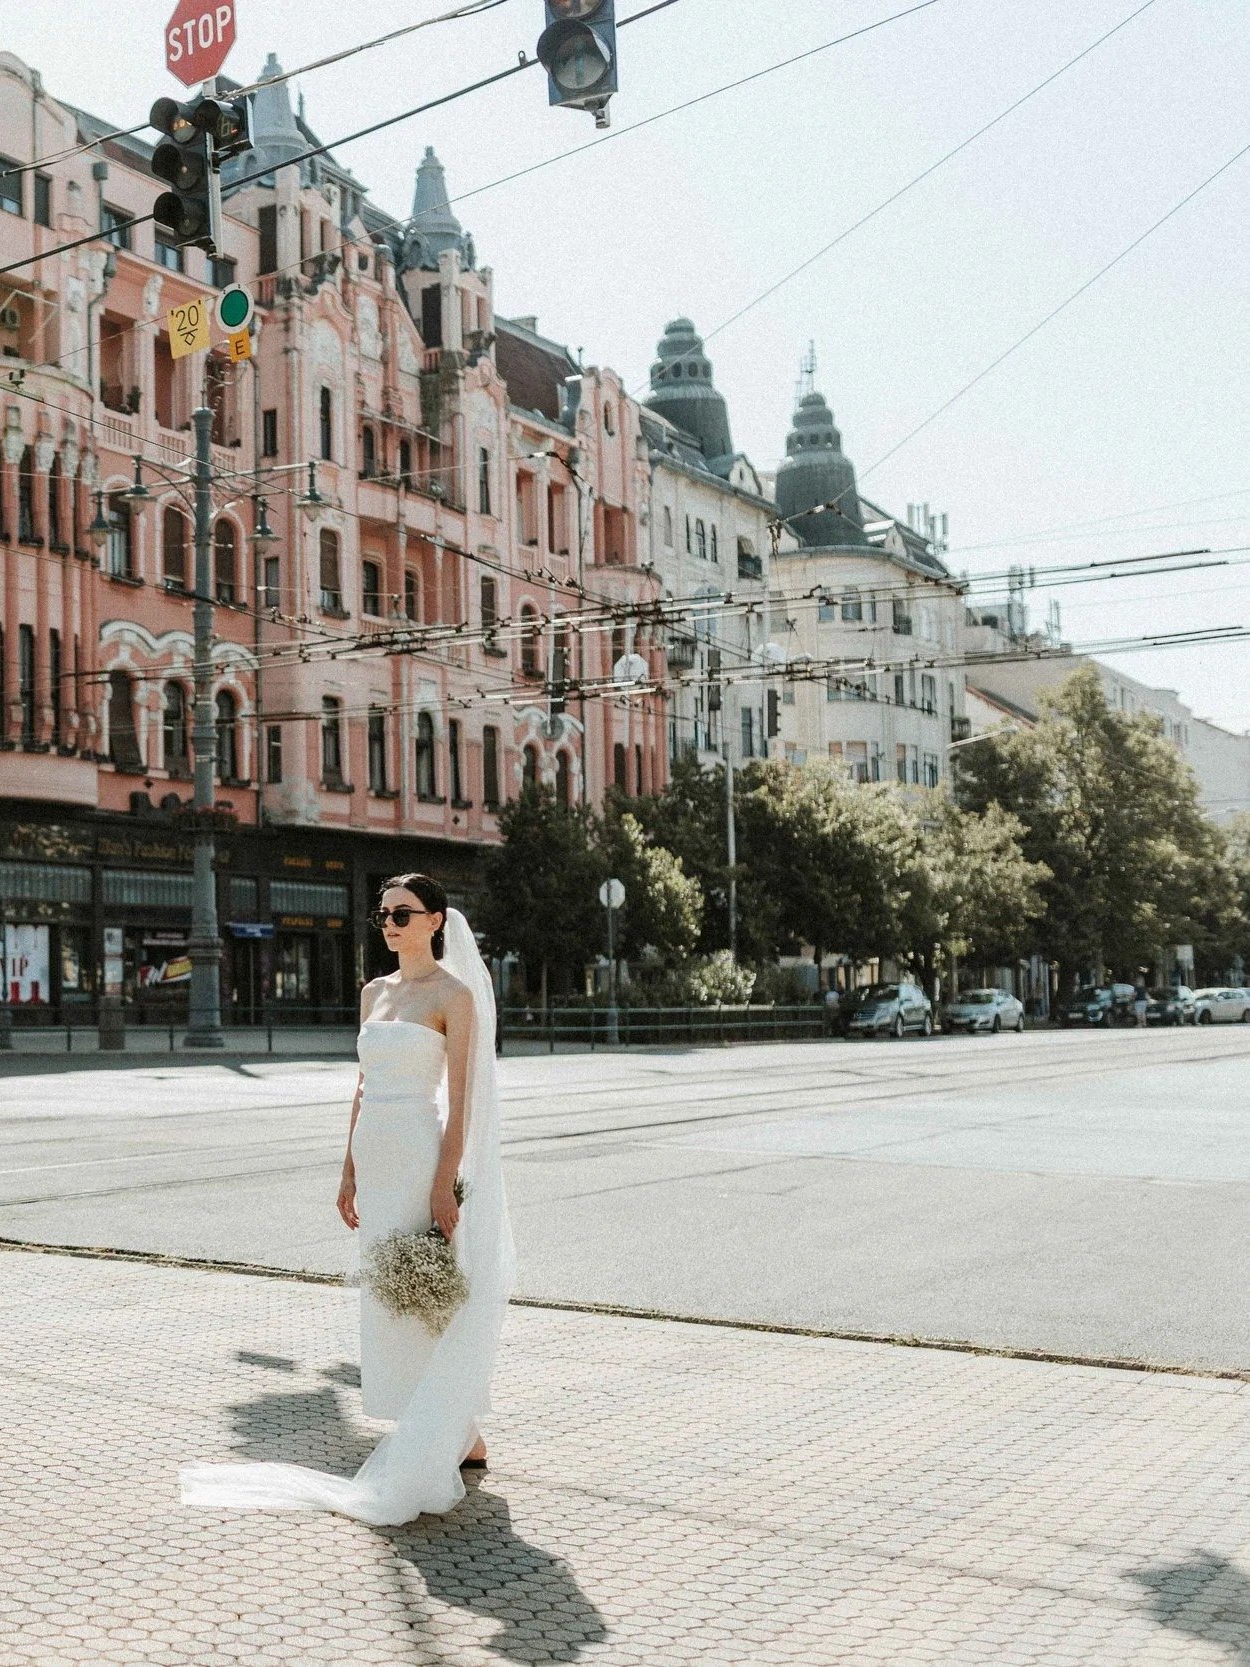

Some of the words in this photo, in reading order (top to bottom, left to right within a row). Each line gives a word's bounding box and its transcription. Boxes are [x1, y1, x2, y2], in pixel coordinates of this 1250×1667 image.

[168, 5, 232, 62] STOP
[176, 305, 199, 332] 20
[235, 340, 246, 356] E
[0, 957, 29, 977] VIP
